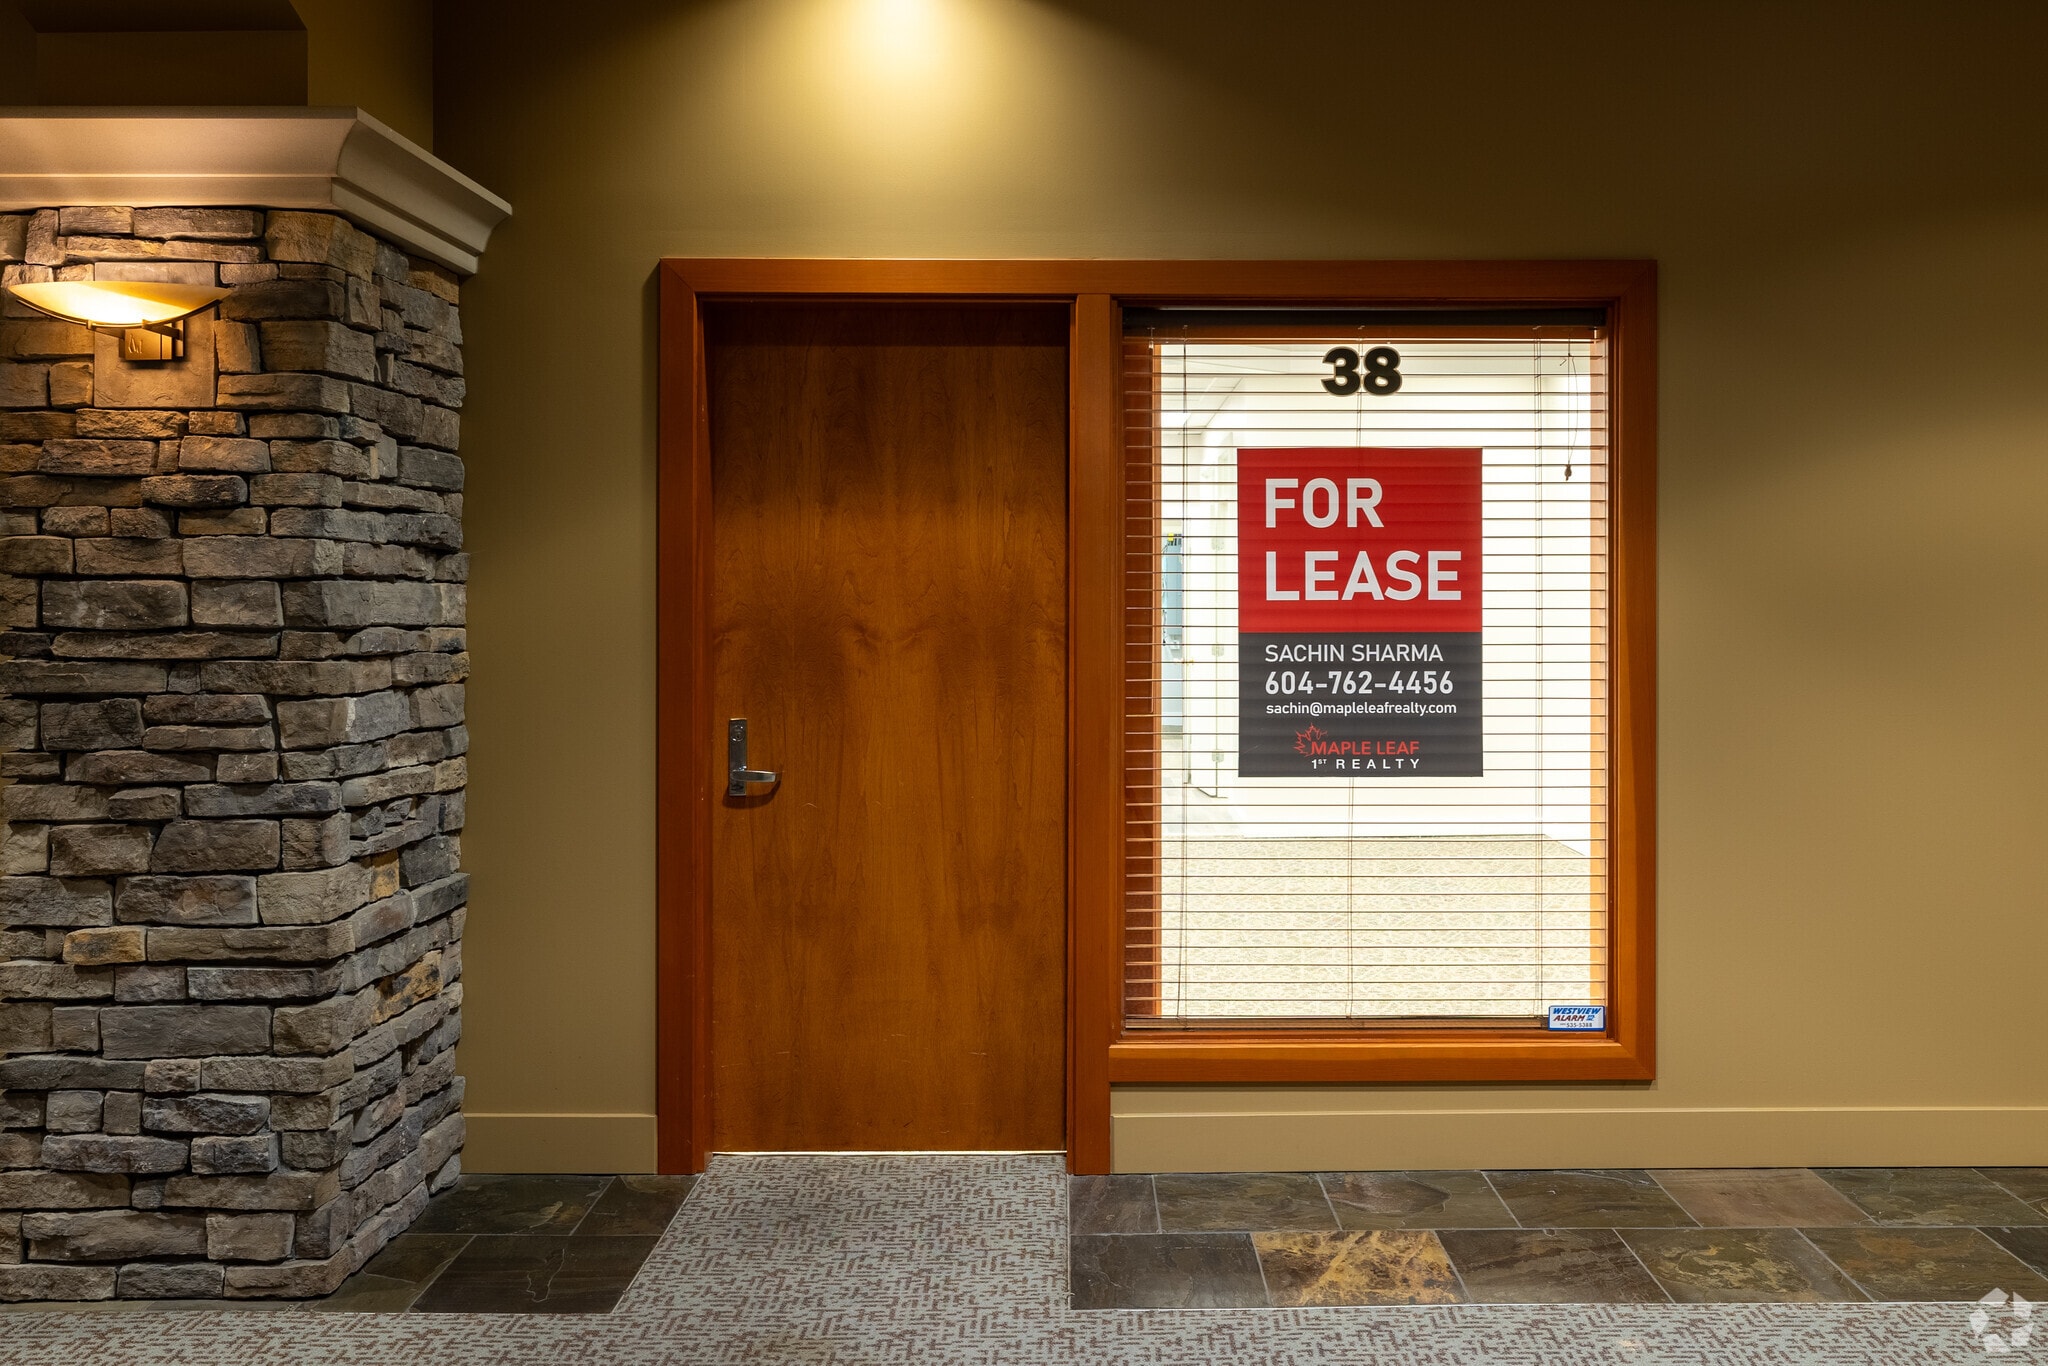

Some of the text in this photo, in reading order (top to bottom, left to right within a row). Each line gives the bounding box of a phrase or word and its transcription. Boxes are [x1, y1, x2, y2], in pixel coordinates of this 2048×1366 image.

[1321, 346, 1402, 397] 38
[1265, 478, 1384, 528] FOR
[1265, 550, 1461, 601] LEASE
[1265, 644, 1443, 662] SACHIN SHARMA
[1265, 671, 1453, 694] 604-762-4456
[1266, 702, 1457, 716] sachin@mapleleafrealty.com
[1311, 741, 1419, 755] MAPLE LEAF
[1336, 759, 1420, 769] REALTY
